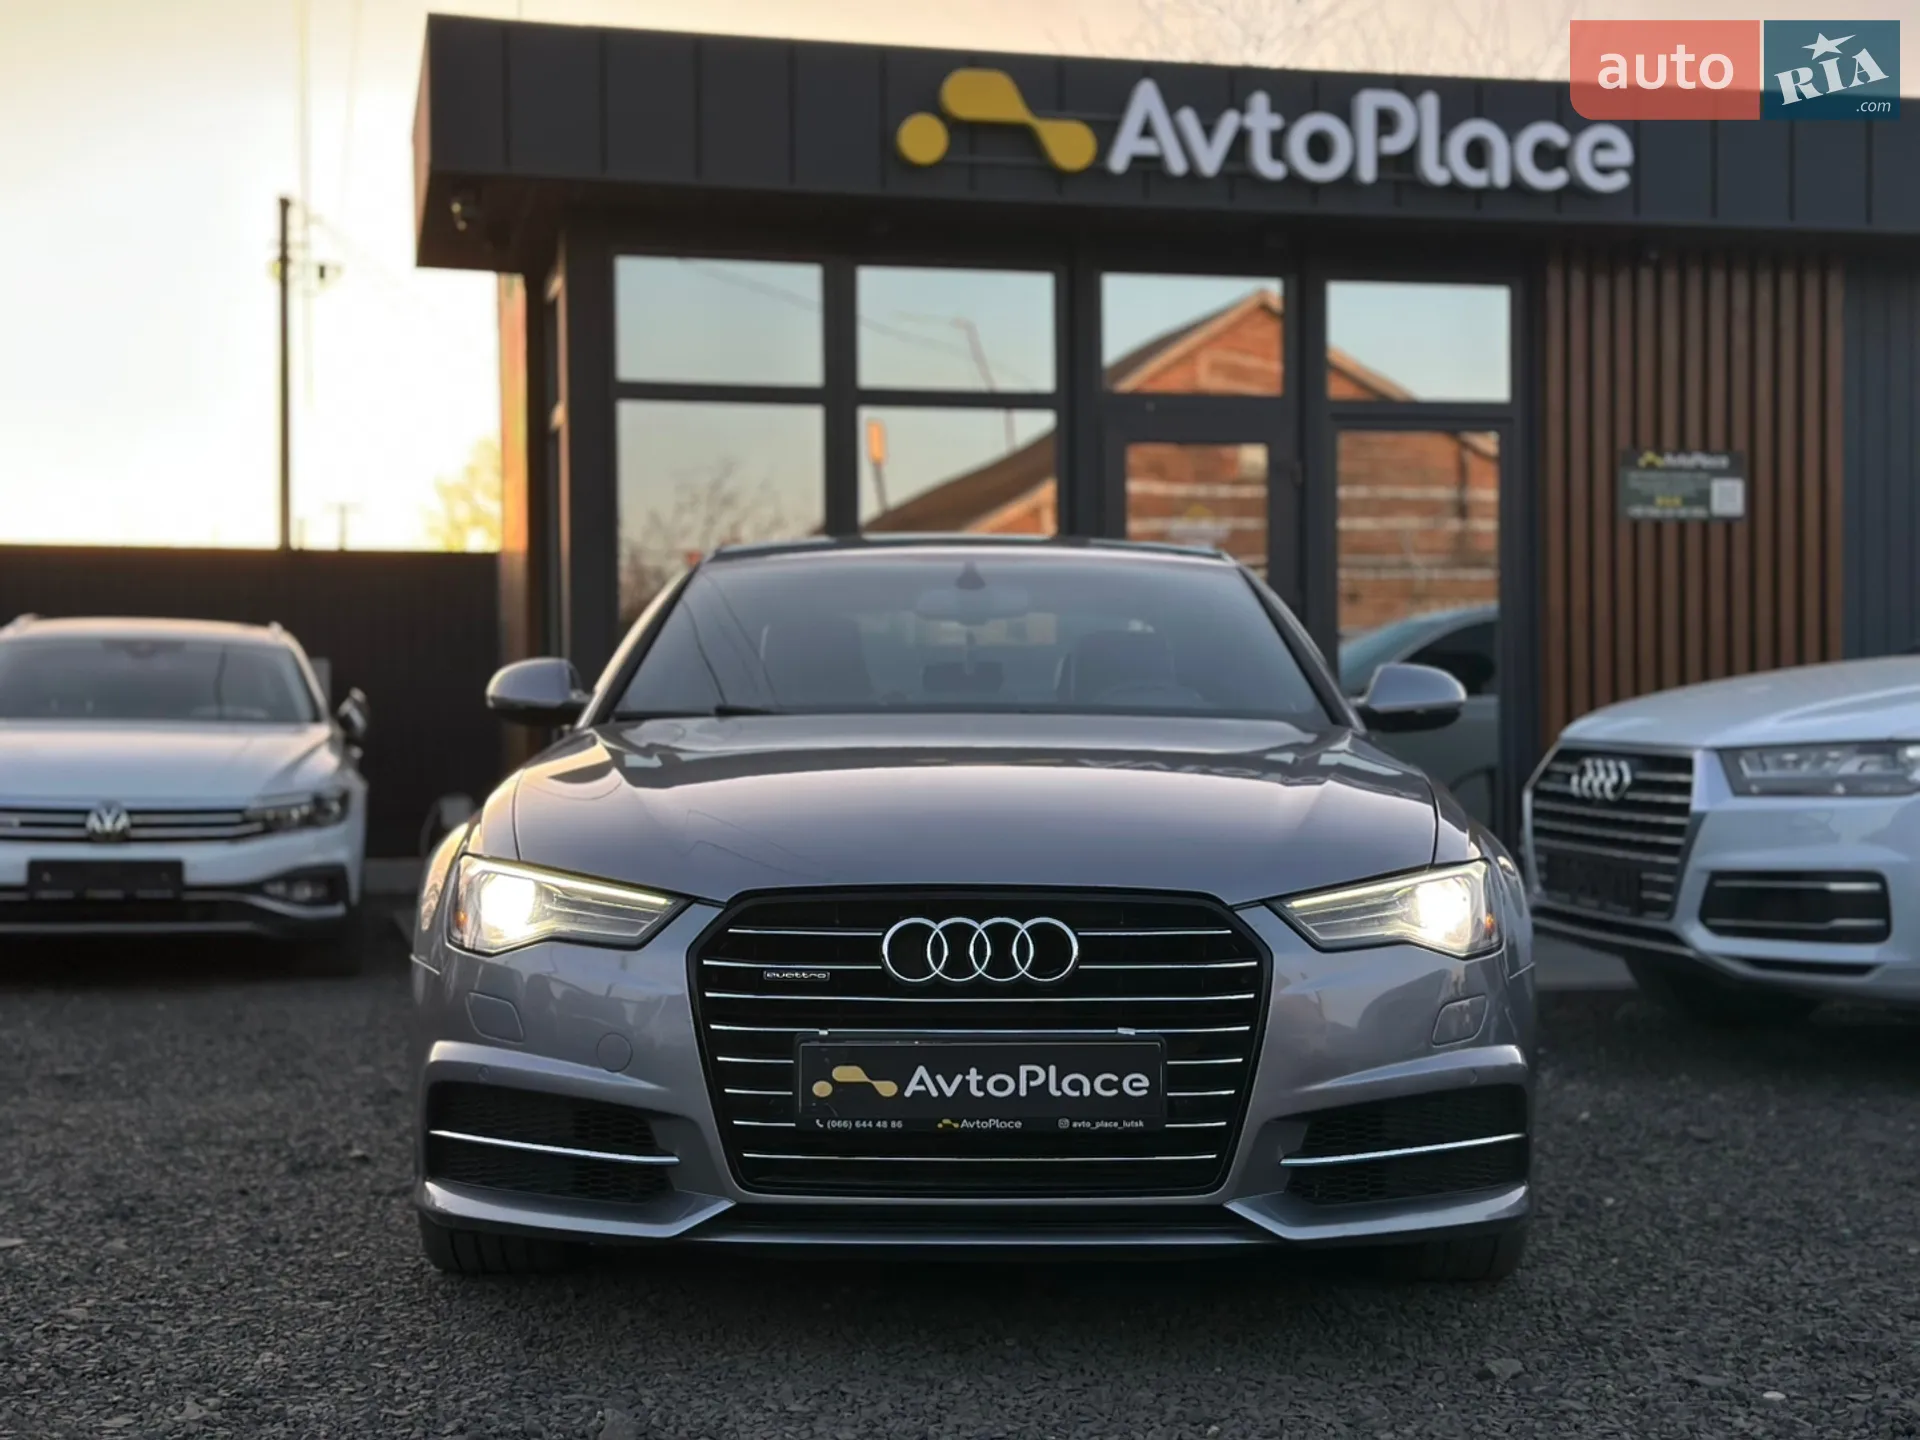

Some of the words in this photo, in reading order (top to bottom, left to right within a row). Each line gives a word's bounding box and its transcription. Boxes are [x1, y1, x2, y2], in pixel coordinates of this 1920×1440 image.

[1107, 78, 1635, 193] AvtoPlace
[766, 971, 827, 979] quattro
[904, 1065, 1150, 1097] AvtoPlace
[826, 1119, 852, 1130] (066)
[854, 1120, 873, 1128] 644
[876, 1120, 888, 1128] 48
[890, 1120, 903, 1128] 86
[960, 1118, 1022, 1129] AvtoPlace
[1072, 1119, 1144, 1130] avto_place_lutsk
